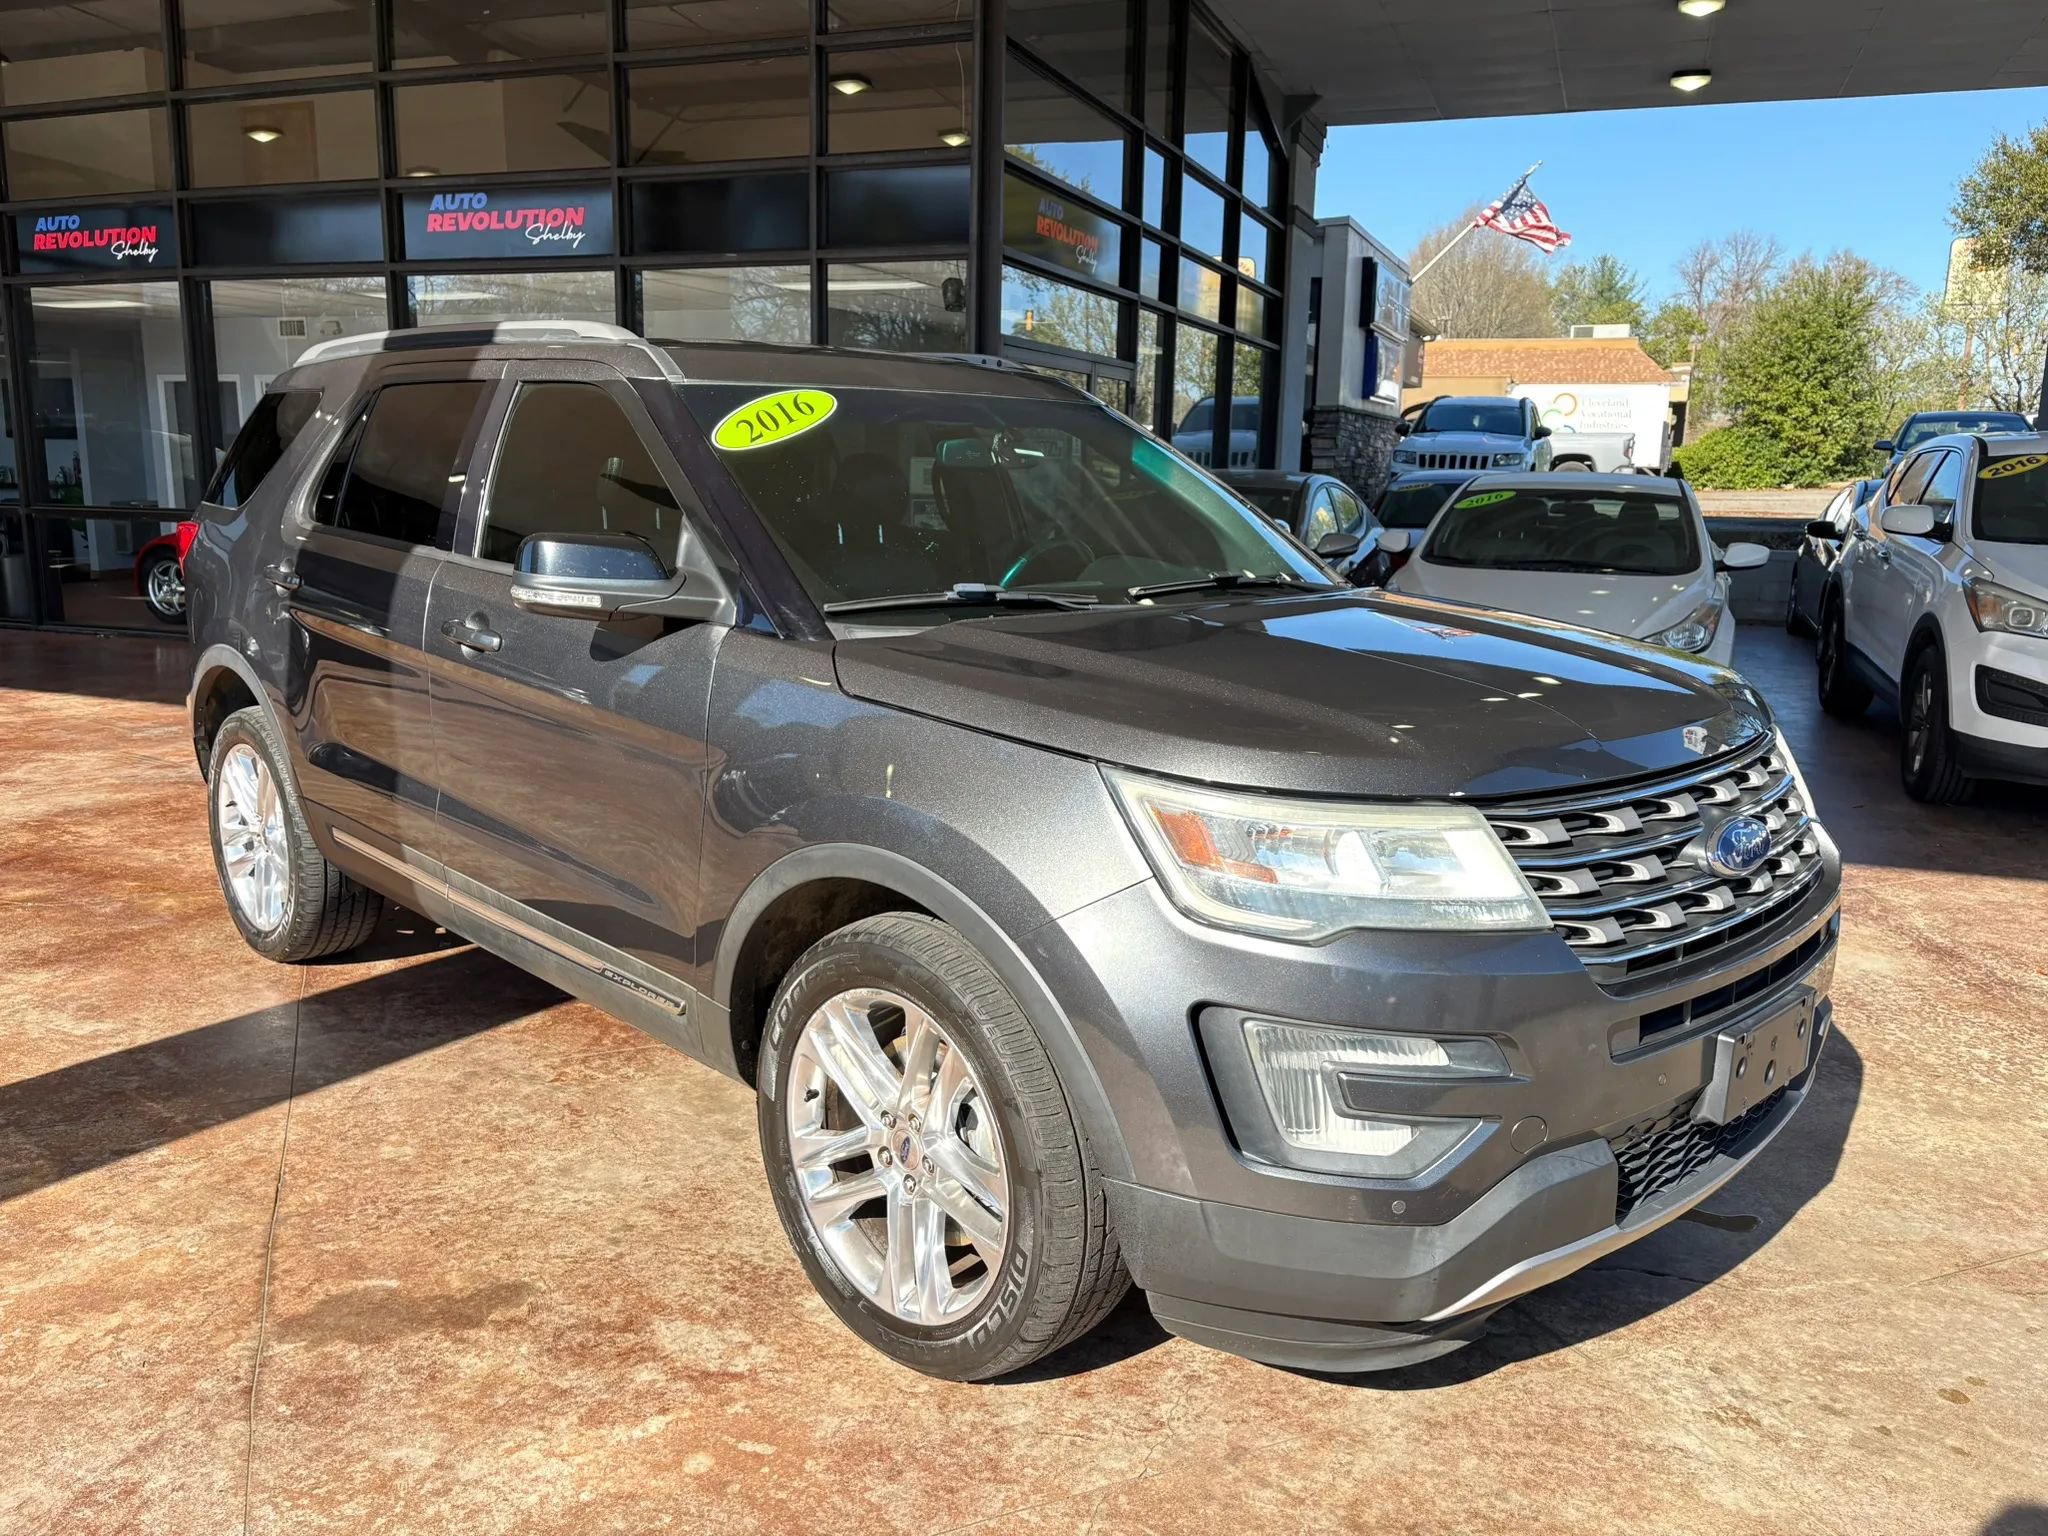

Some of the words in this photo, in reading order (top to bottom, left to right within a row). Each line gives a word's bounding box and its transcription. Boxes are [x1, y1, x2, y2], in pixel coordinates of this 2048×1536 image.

[429, 192, 489, 211] AUTO
[1038, 197, 1064, 221] AUTO
[35, 215, 81, 232] AUTO
[426, 206, 586, 233] REVOLUTION
[33, 226, 157, 251] REVOLUTION
[525, 221, 586, 249] Shelby
[1035, 213, 1099, 254] REVOLUTION
[111, 239, 159, 263] Shelby
[735, 393, 816, 443] 2016
[1988, 456, 2041, 477] 2016
[1467, 493, 1504, 506] 2016
[1731, 826, 1764, 863] Ford
[603, 969, 675, 1008] EXPLORER
